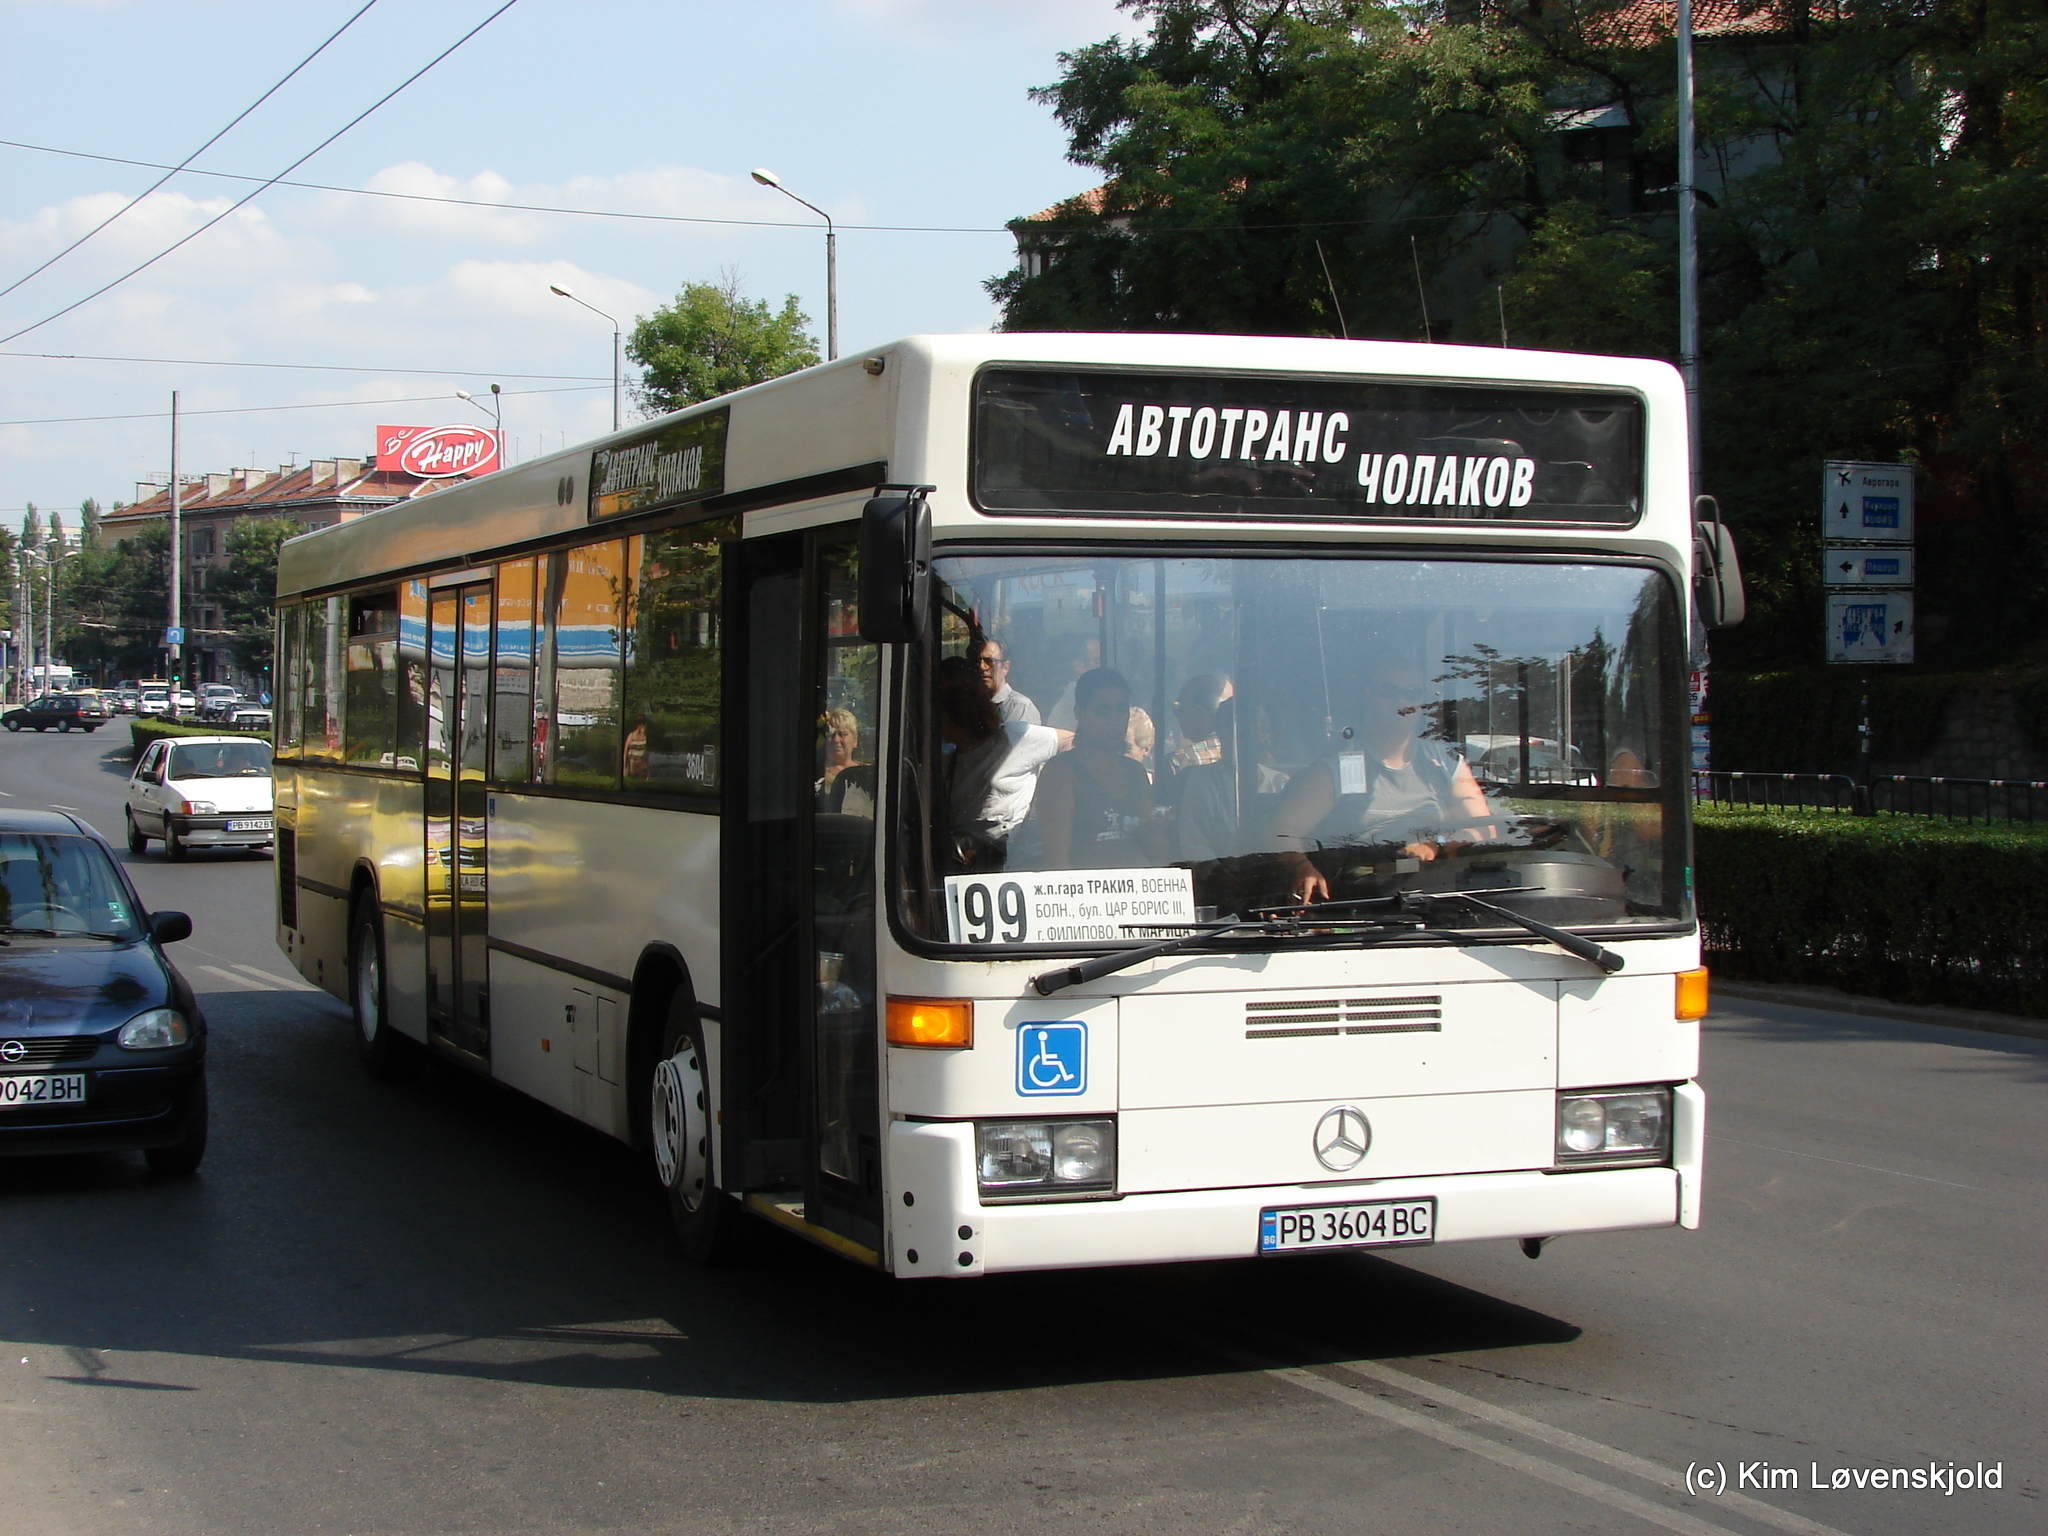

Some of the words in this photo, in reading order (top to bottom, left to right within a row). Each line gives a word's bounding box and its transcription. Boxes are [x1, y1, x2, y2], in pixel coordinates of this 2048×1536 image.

[1106, 403, 1350, 464] АВТОТРАНС
[418, 438, 486, 471] Happy
[1357, 453, 1535, 507] ЧОЛАКОВ
[1862, 476, 1900, 489] Аерогара
[686, 752, 704, 780] 3604
[1087, 879, 1138, 895] ТРАКИЯ,
[1142, 878, 1188, 893] ВОЕННА
[964, 881, 1028, 944] 99
[1079, 903, 1102, 919] бул.
[1105, 902, 1128, 919] ЦАР
[1131, 901, 1169, 916] БОРИС
[1264, 1235, 1276, 1244] BG
